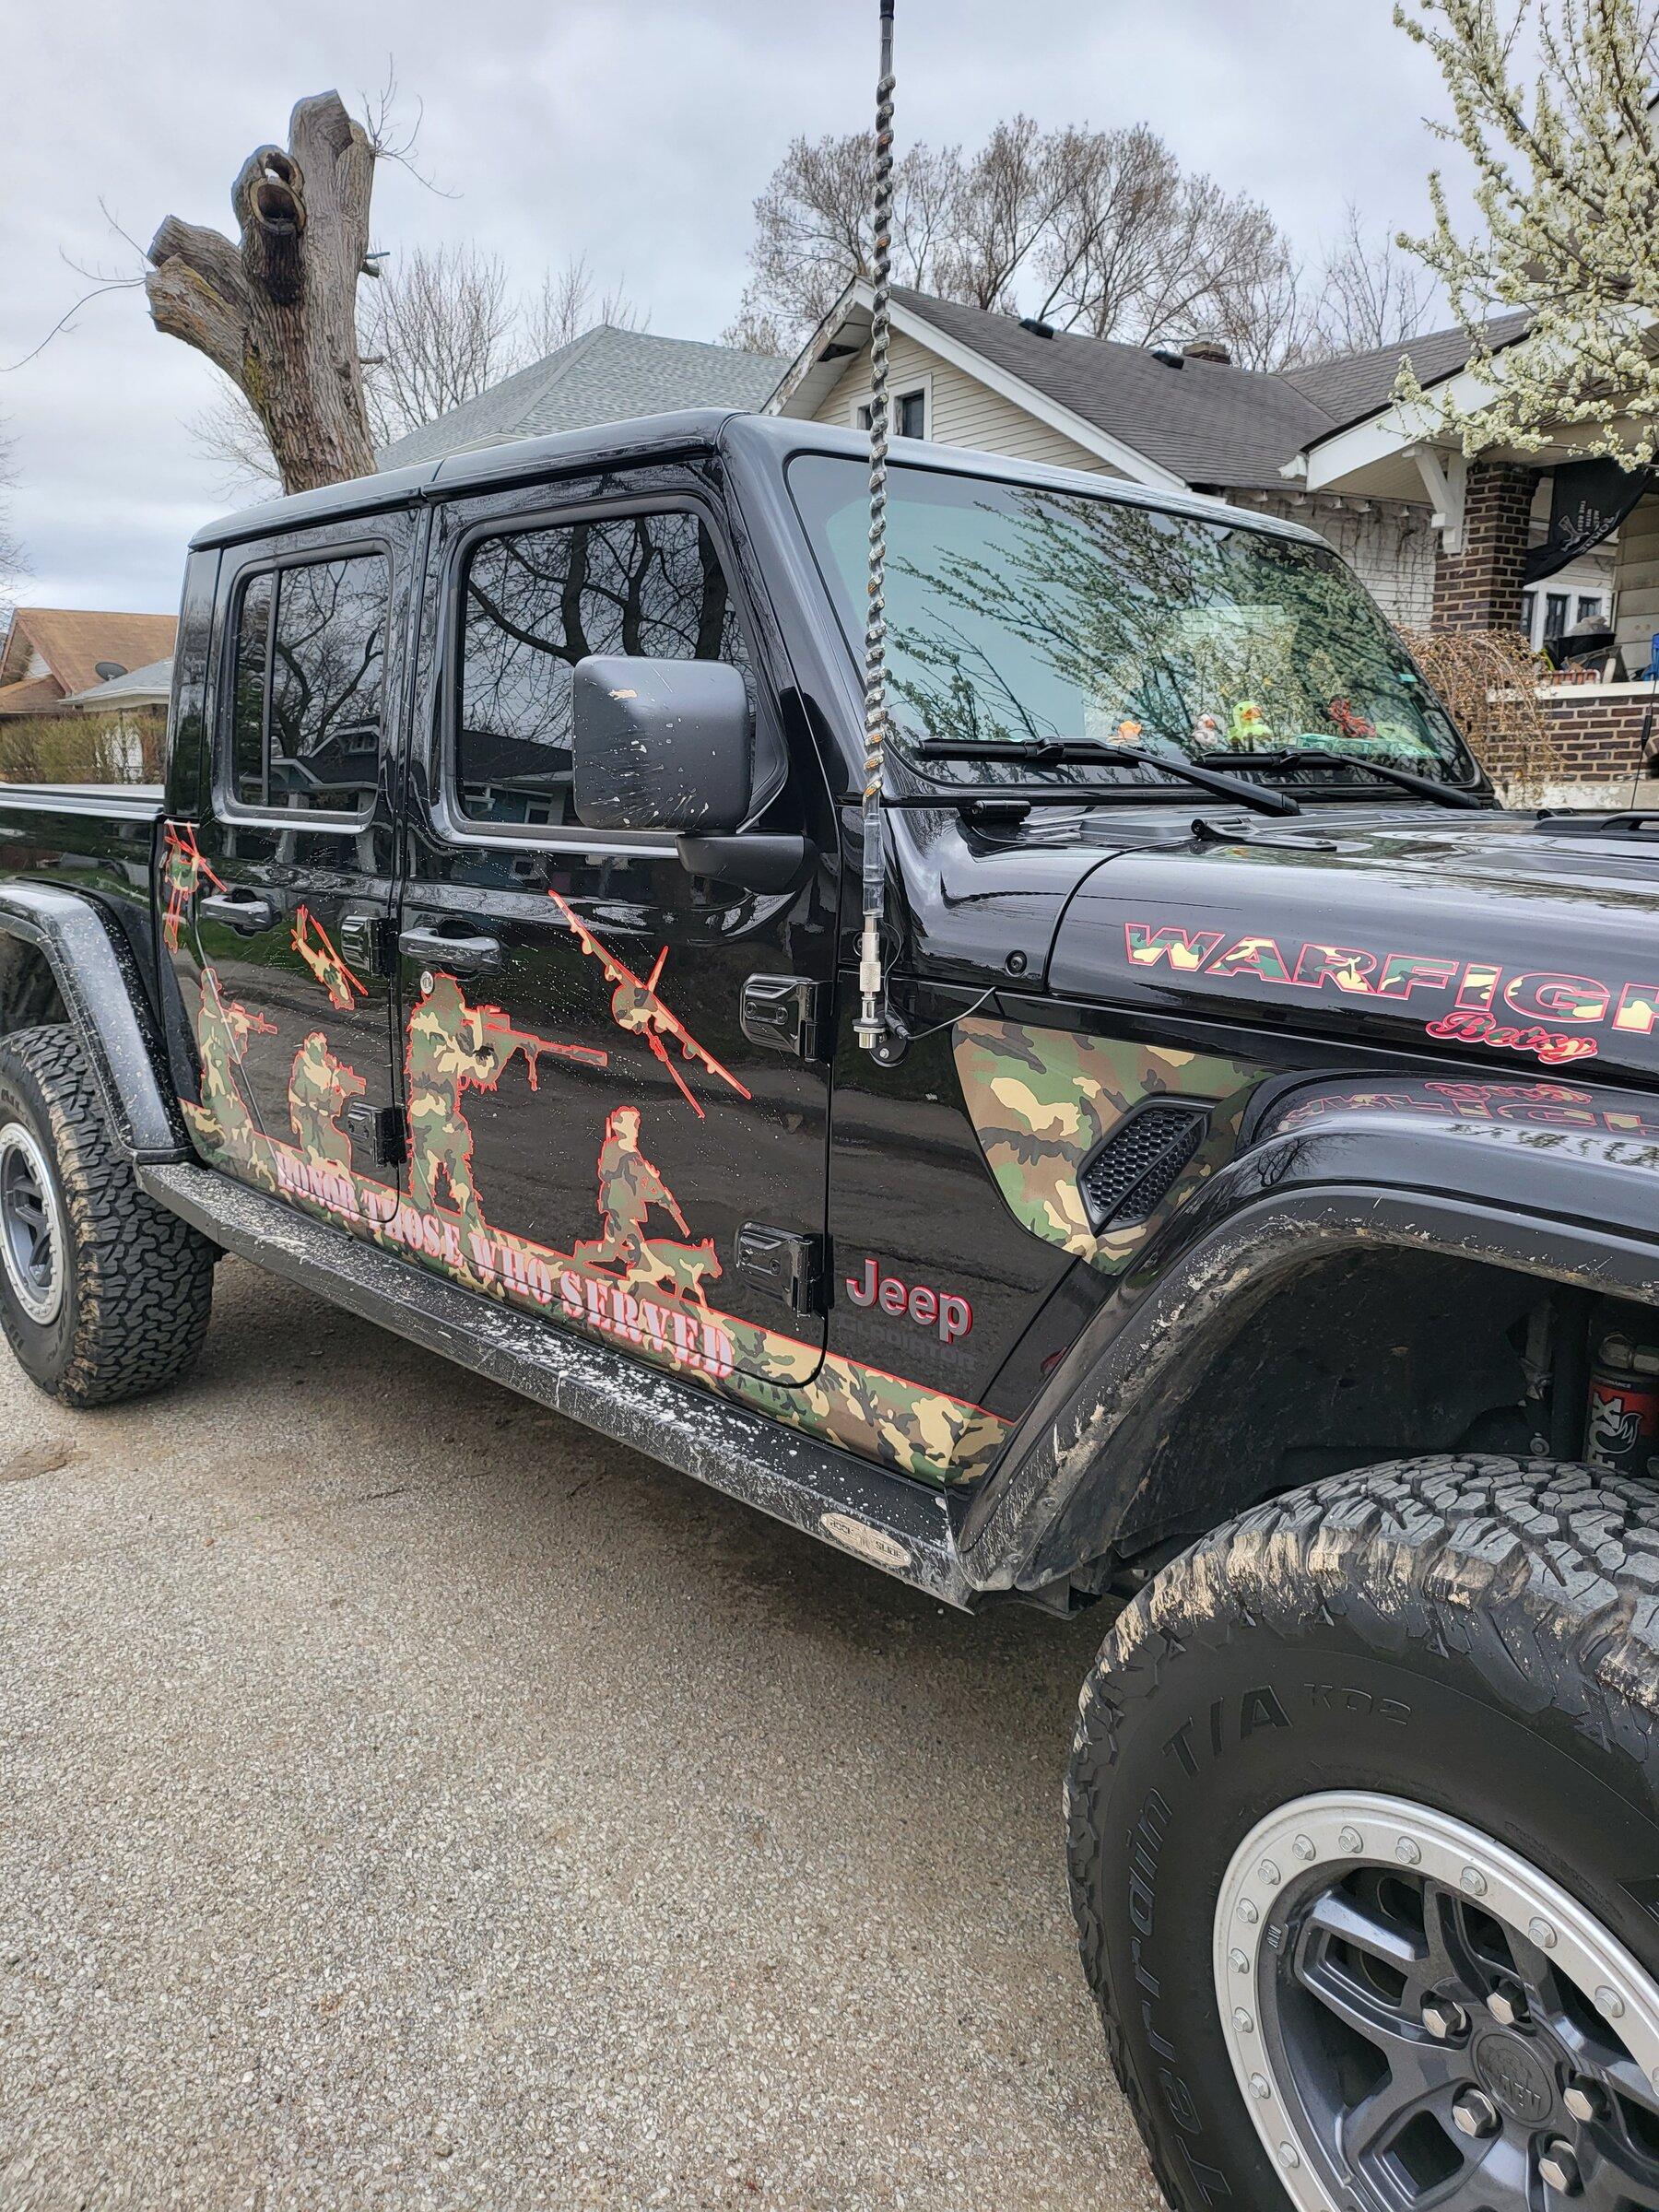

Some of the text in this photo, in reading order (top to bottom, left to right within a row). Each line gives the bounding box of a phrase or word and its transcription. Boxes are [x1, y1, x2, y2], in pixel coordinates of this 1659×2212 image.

[1425, 1010, 1598, 1065] Betsy
[275, 1149, 735, 1380] HONOR THOSE WHO SERVED
[845, 1258, 973, 1344] Jeep
